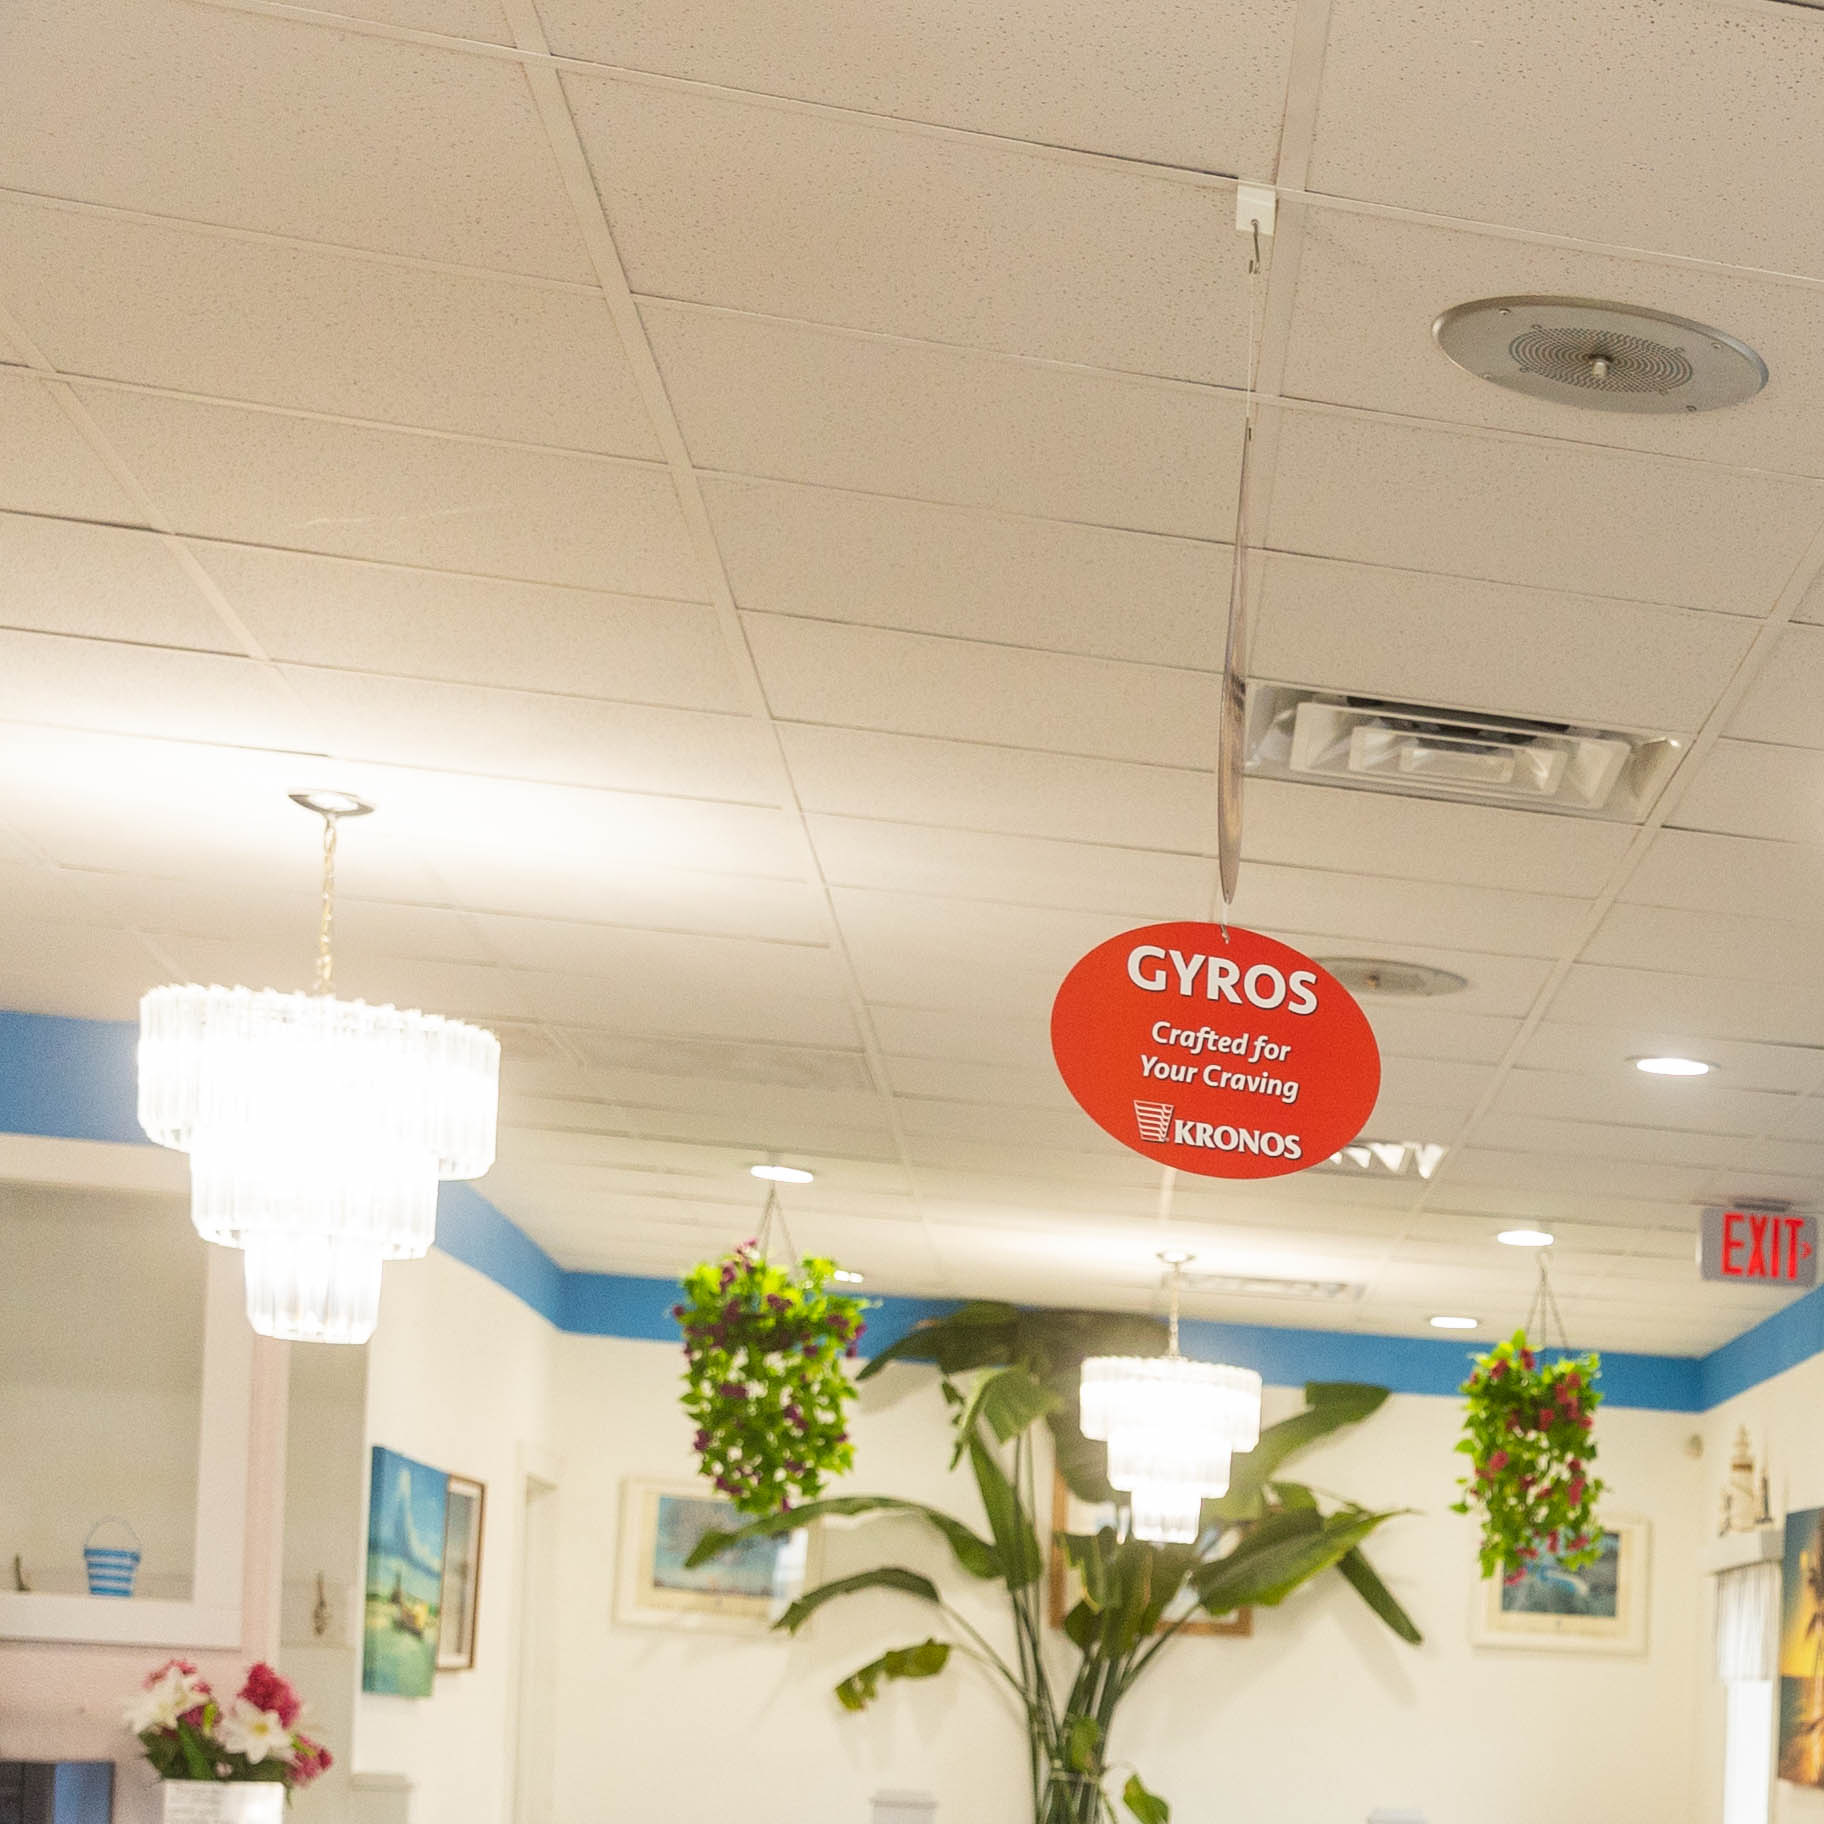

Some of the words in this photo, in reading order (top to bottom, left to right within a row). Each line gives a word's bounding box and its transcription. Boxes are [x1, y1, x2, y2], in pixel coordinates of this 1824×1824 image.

[1126, 945, 1319, 1016] GYROS
[1151, 1021, 1249, 1057] Crafted
[1248, 1035, 1292, 1063] for
[1140, 1055, 1198, 1084] Your
[1202, 1064, 1300, 1104] Craving
[1174, 1119, 1302, 1160] KRONOS
[1721, 1212, 1805, 1281] EXIT
